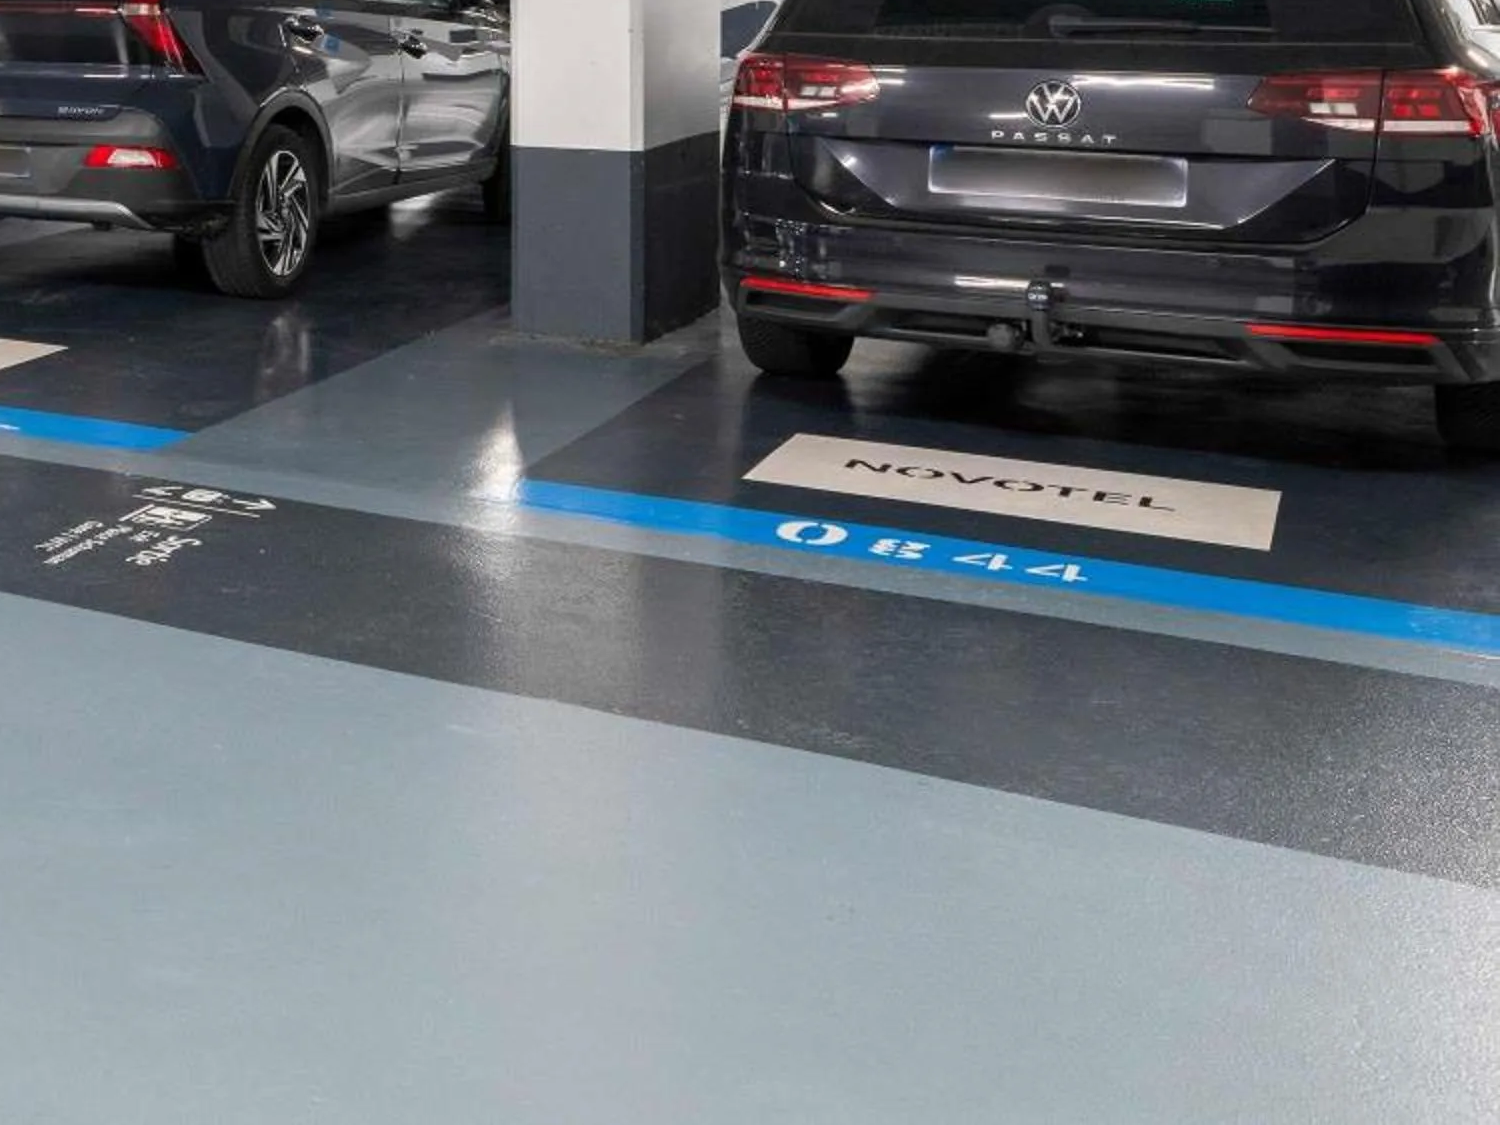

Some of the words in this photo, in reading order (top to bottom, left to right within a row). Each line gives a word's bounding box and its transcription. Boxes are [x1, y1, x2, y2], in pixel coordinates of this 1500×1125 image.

[990, 130, 1117, 146] PASSAT
[843, 458, 1177, 513] NOVOTEL
[775, 520, 1088, 583] 0844
